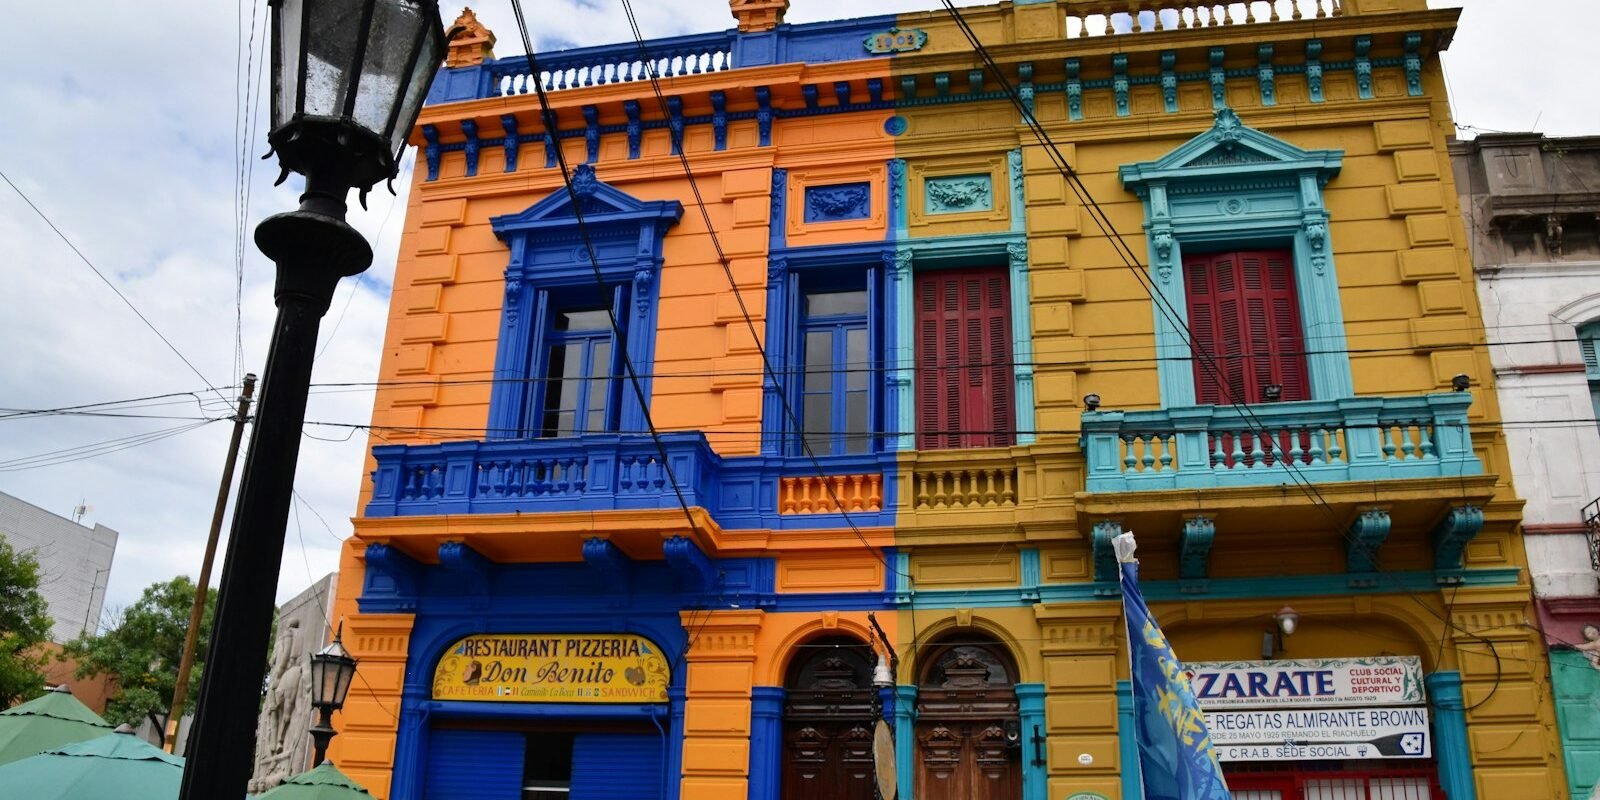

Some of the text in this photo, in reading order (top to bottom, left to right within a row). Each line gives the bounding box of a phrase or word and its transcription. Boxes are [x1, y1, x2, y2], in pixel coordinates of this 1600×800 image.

[464, 639, 640, 660] RESTAURANT PIZZERIA
[481, 660, 616, 684] Don Benito
[1197, 670, 1336, 699] ZARATE
[1351, 677, 1392, 685] CULTURAL
[442, 686, 494, 697] CAFETERIA
[601, 687, 655, 697] SANDWICH
[1352, 685, 1401, 694] DEPORTIVO
[1204, 710, 1424, 730] E REGATAS ALMIRANTE BROWN
[1282, 730, 1320, 738] REMANDO
[1229, 746, 1351, 758] C.R.A.B. SEDE SOCIAL
